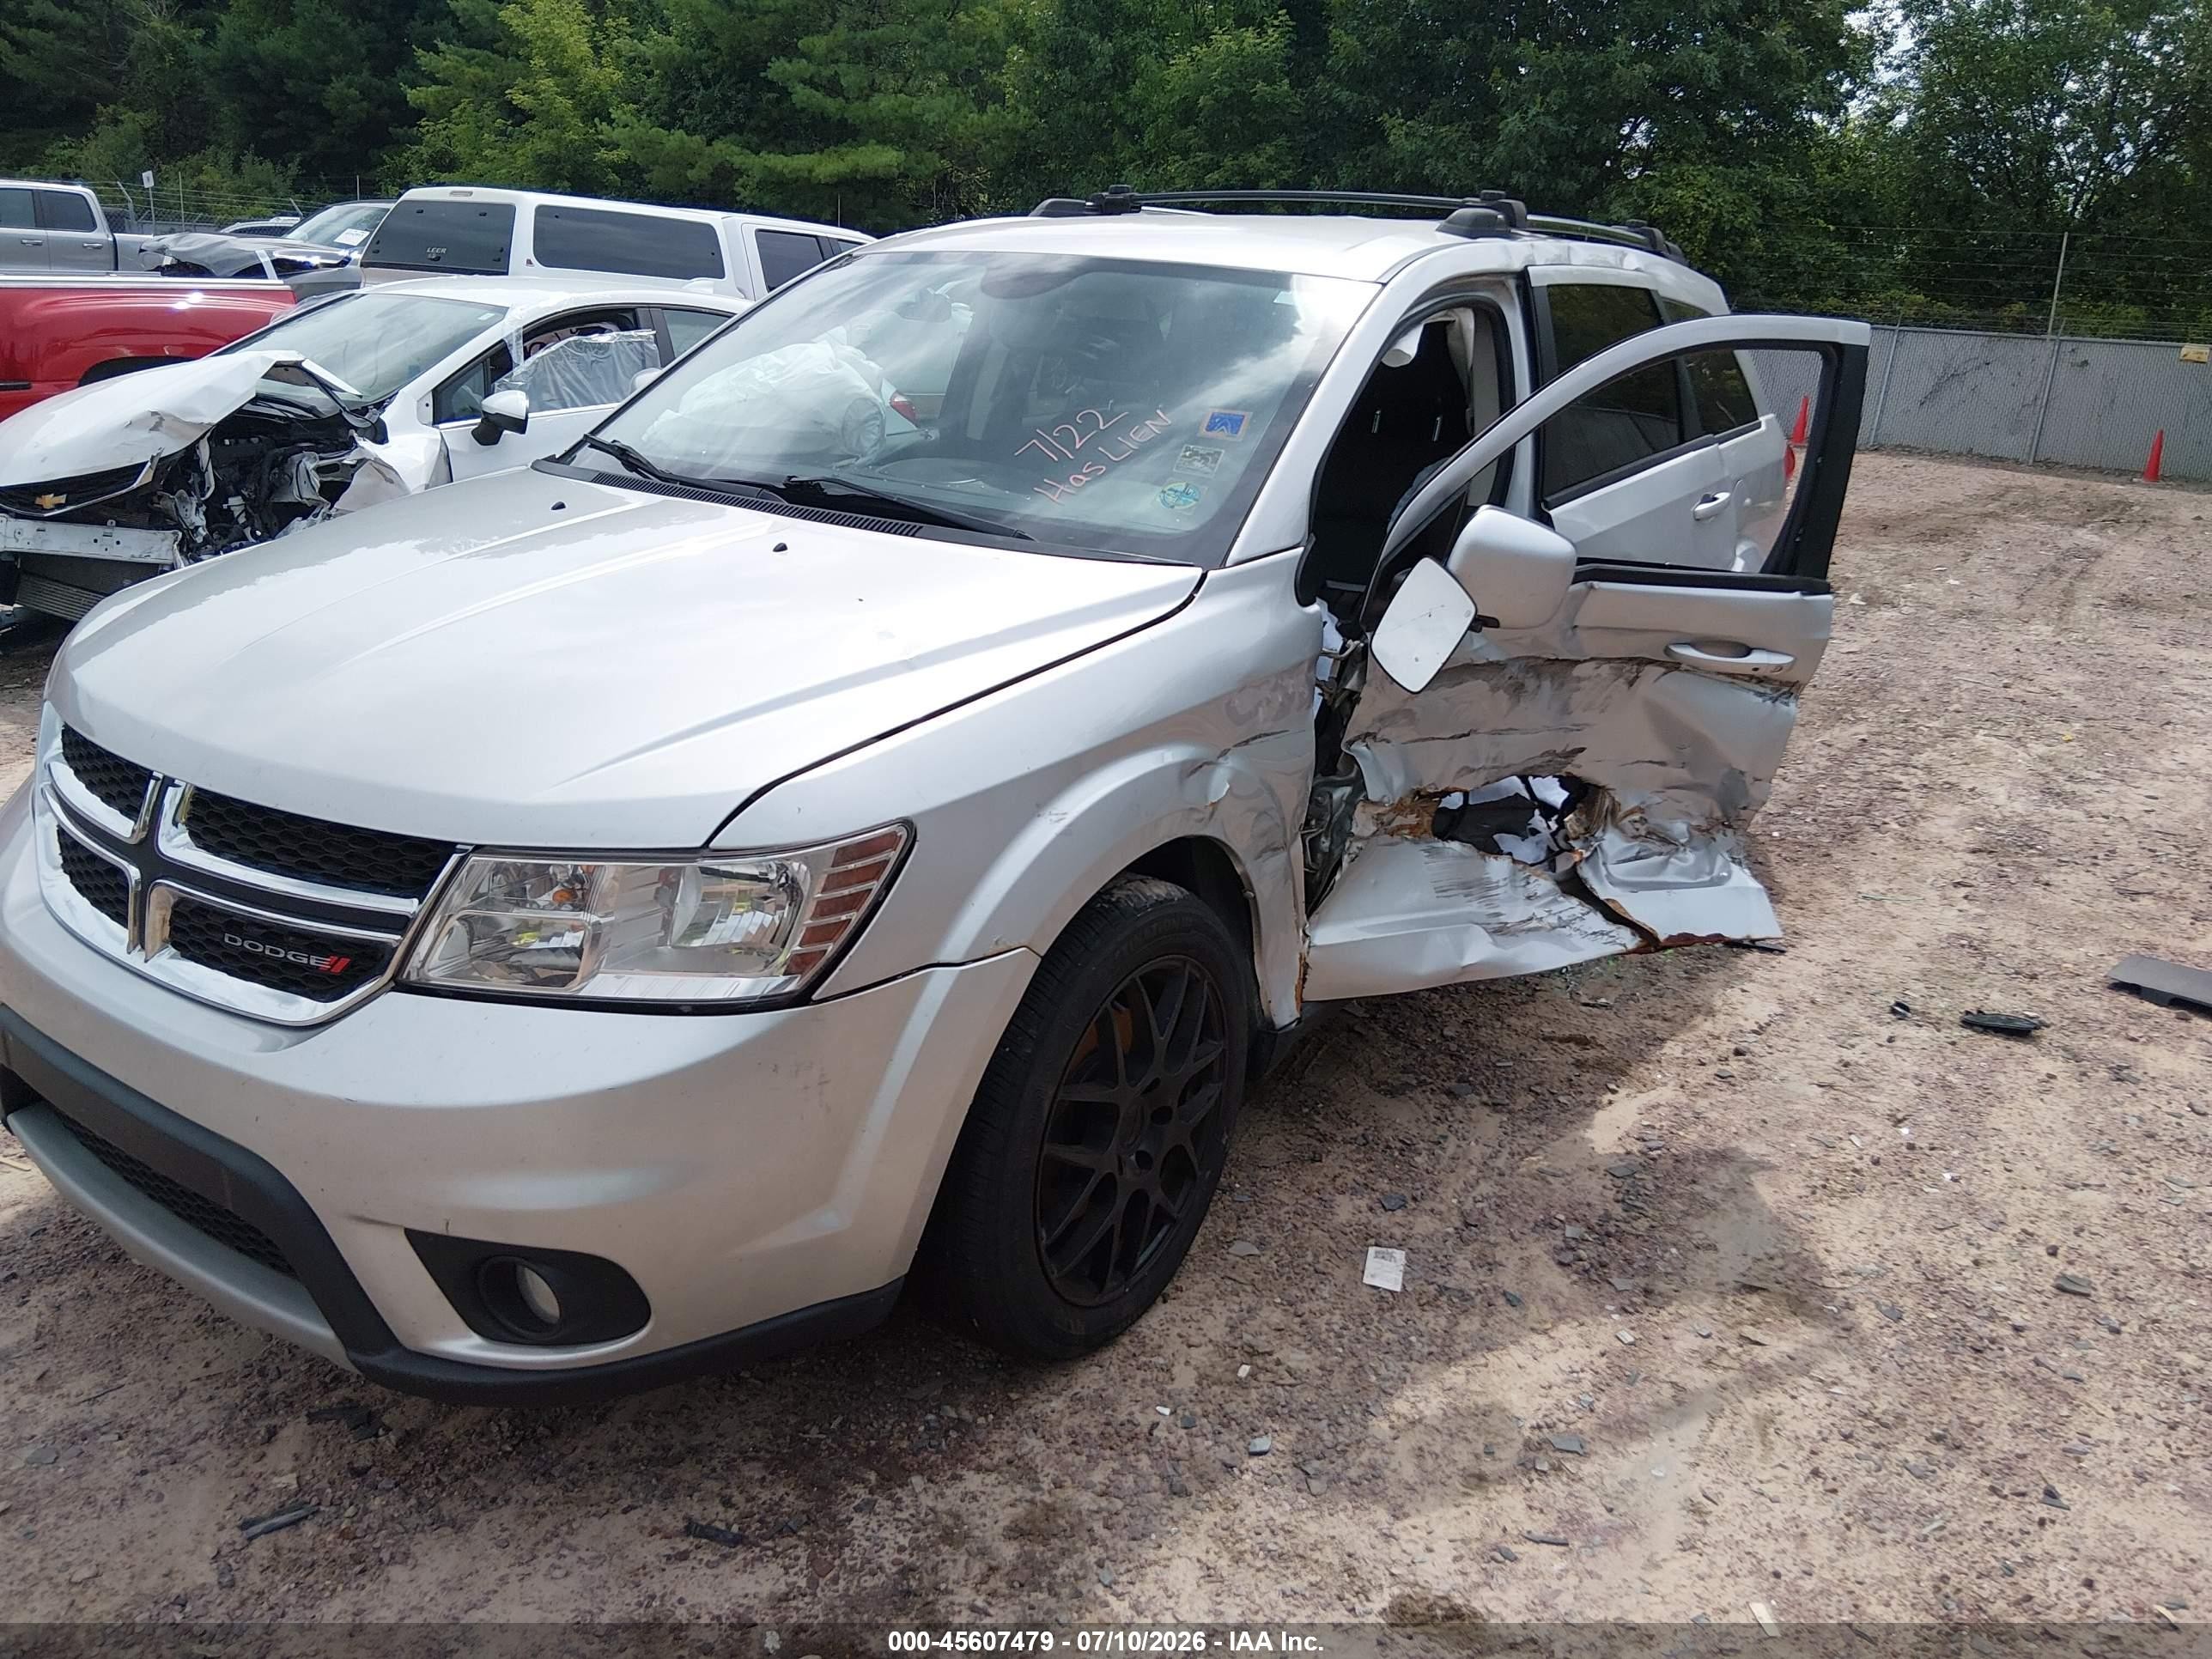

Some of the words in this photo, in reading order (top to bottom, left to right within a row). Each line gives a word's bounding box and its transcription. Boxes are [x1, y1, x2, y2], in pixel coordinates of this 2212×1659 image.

[1013, 408, 1130, 462] 7/22
[1097, 408, 1172, 462] LIEN
[223, 932, 331, 969] DODGE
